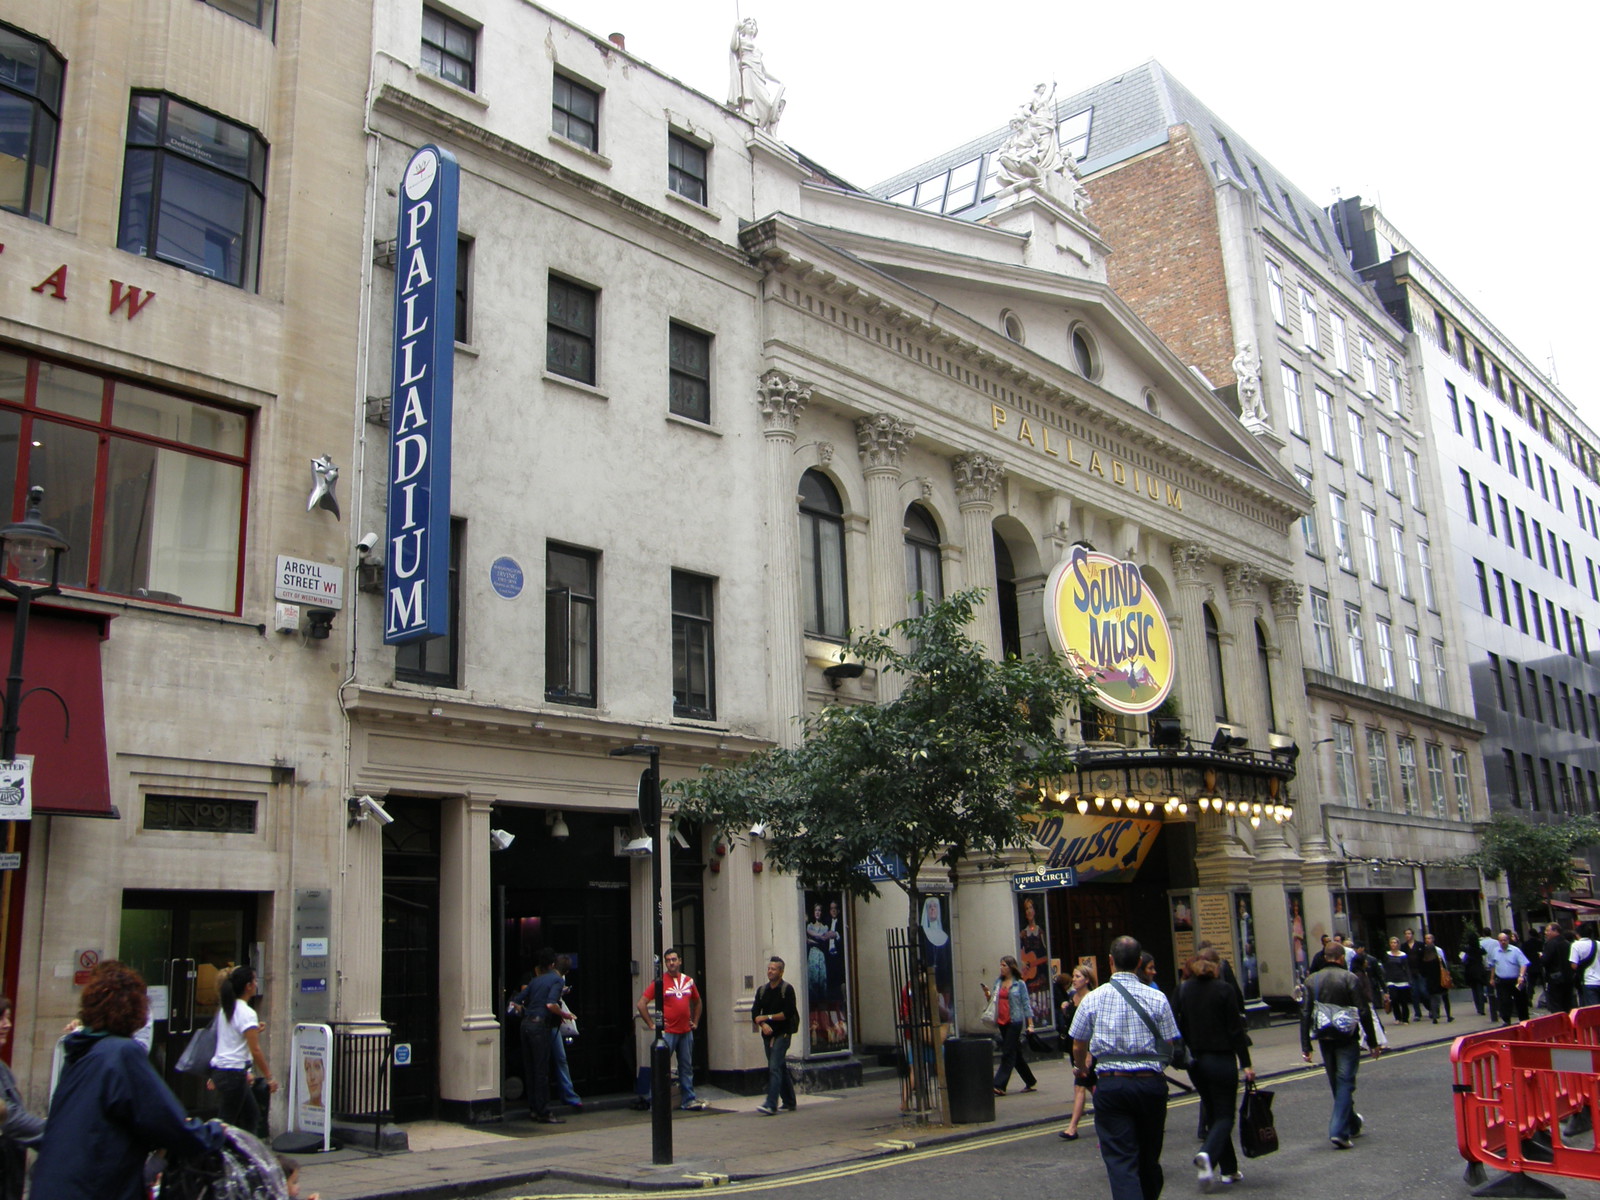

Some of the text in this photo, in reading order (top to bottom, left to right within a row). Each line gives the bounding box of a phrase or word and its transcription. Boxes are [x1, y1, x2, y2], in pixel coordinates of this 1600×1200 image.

[387, 200, 433, 633] PALLADIUM
[991, 403, 1182, 511] PALLADIUM
[283, 574, 337, 594] STREET W1
[284, 561, 322, 578] ARGYLL
[301, 595, 333, 605] WESTMINSTER
[1089, 611, 1156, 667] MUSIC
[1046, 820, 1134, 869] MUSIC
[1015, 871, 1071, 884] UPPER CIRCLE
